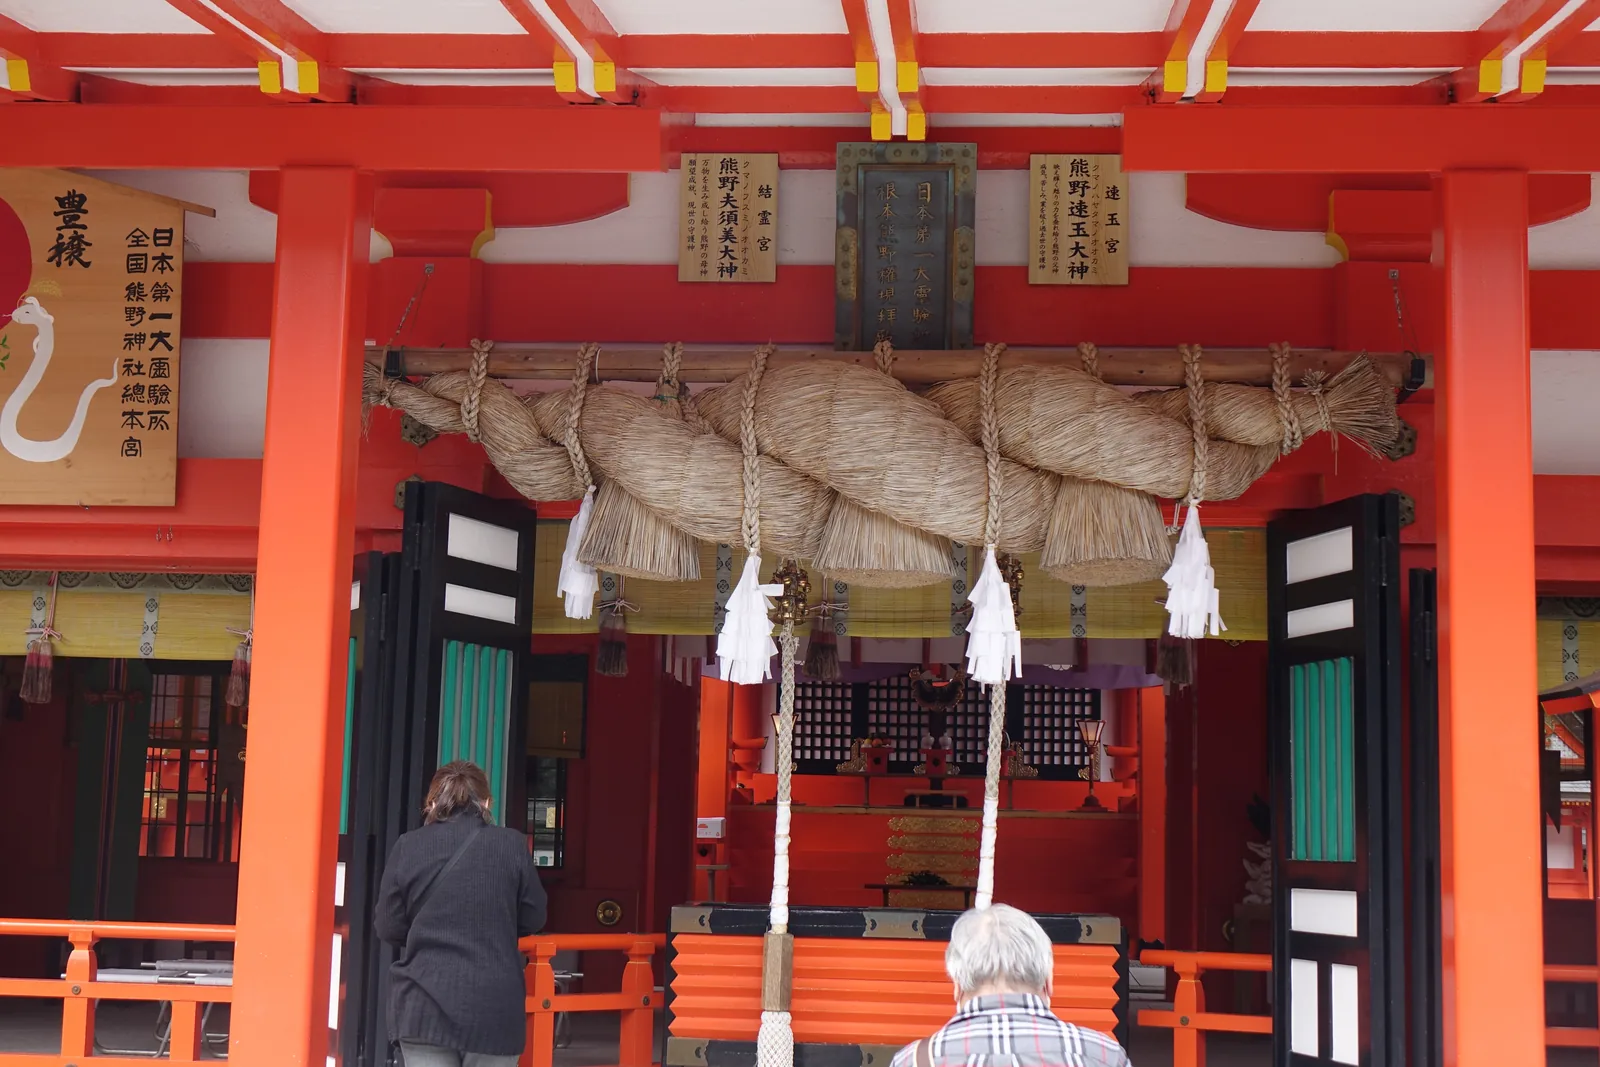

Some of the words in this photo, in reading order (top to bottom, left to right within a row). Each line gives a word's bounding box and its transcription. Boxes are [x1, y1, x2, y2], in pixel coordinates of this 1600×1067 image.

[717, 157, 740, 279] 熊野夫須美大神
[741, 161, 750, 275] クマノフスミノオオカミ
[757, 184, 772, 252] 結霊宮
[1067, 158, 1091, 280] 熊野速玉大神
[1105, 185, 1121, 254] 速玉宮
